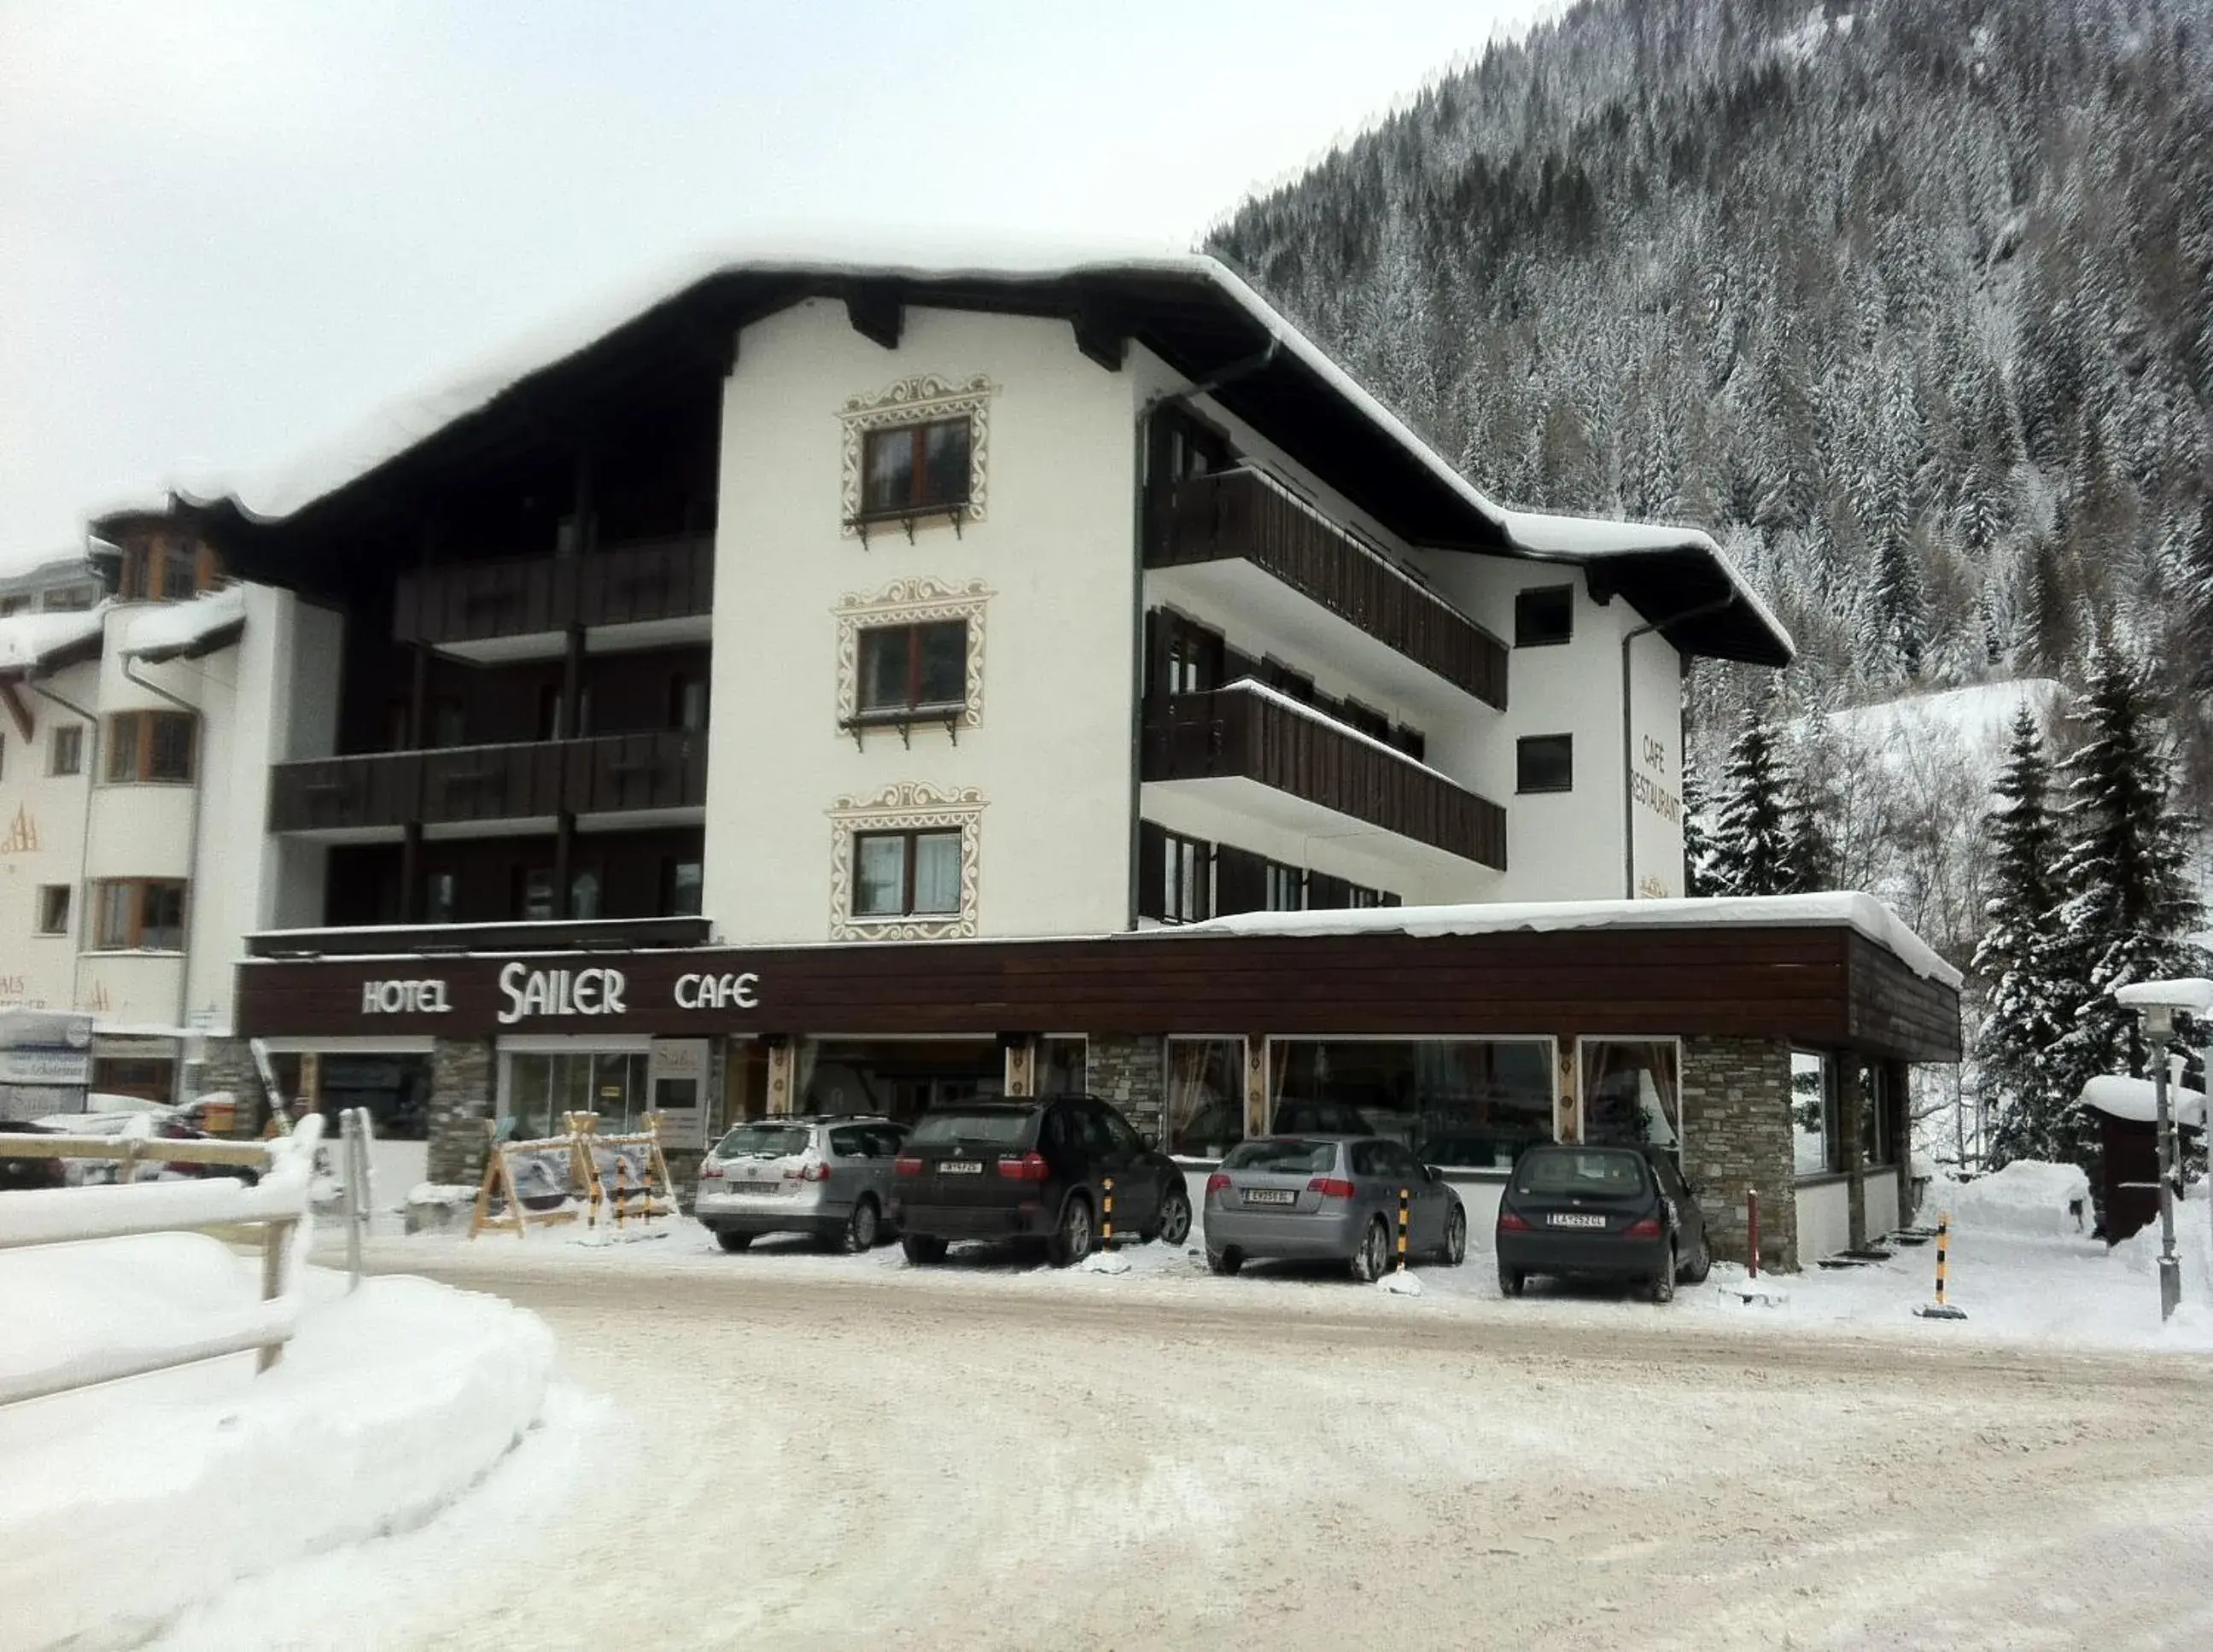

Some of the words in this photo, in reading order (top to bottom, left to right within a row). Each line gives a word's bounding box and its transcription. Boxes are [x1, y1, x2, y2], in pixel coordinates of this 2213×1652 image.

[1632, 770, 1679, 825] ESTAURANT
[362, 978, 454, 1014] HOTEL
[497, 961, 628, 1024] SAILER
[674, 972, 762, 1009] CAFE
